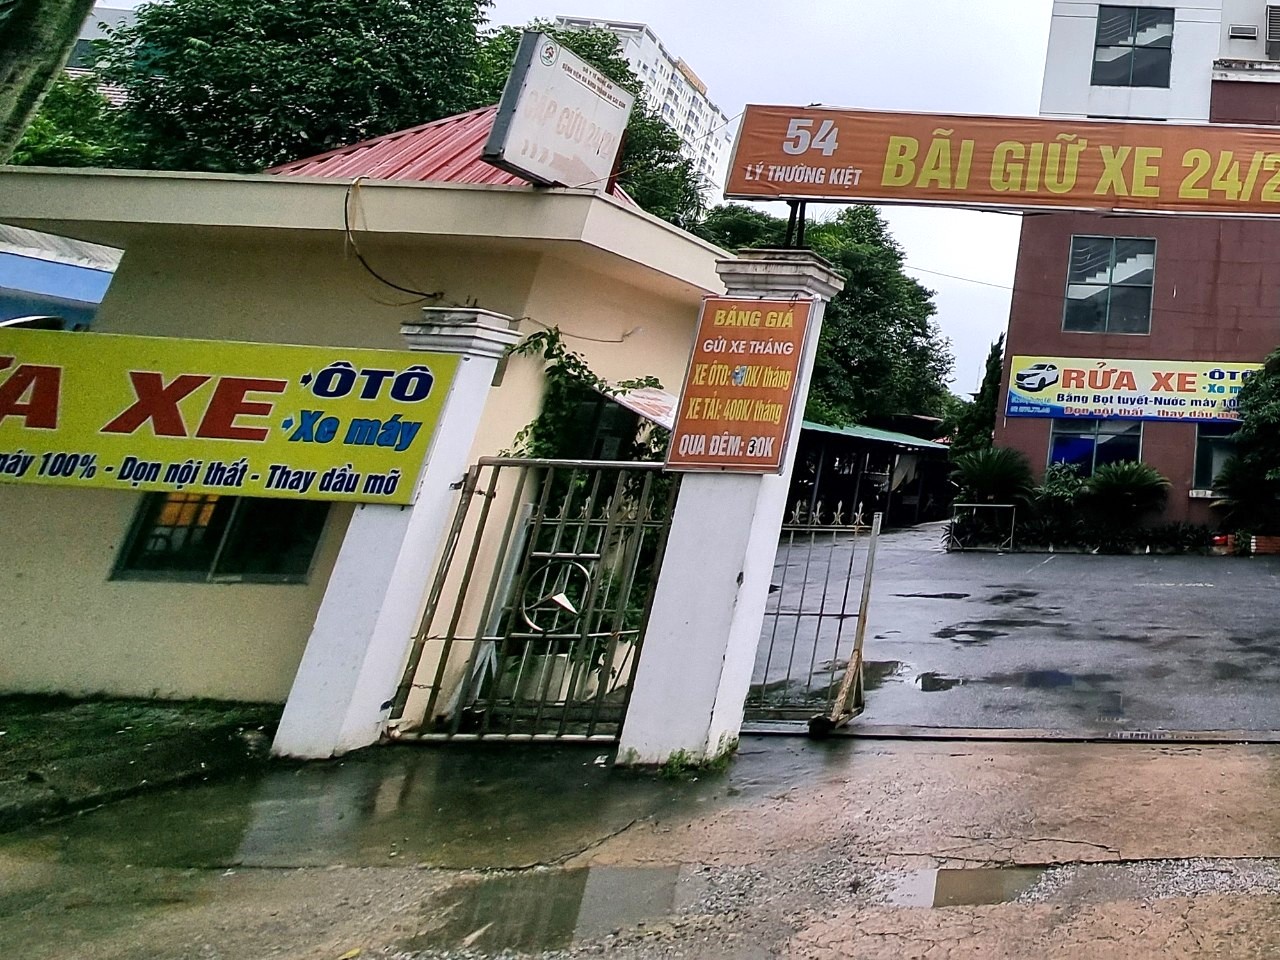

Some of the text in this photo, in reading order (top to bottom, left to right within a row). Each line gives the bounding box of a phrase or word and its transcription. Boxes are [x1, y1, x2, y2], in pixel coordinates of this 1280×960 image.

[782, 118, 840, 156] 54
[745, 161, 863, 189] LÝ THƯỜNG KIỆT
[881, 128, 975, 190] BÃI
[990, 133, 1088, 194] GIỮ
[1094, 145, 1163, 198] XE
[713, 305, 794, 328] BẢNG GIÁ
[702, 335, 795, 355] GỬI XE THÁNG
[313, 361, 435, 403] ÔTÔ
[692, 363, 709, 386] XE
[762, 365, 793, 391] tháng
[1061, 361, 1198, 393] RỬA XE
[1207, 383, 1225, 394] Xe
[100, 372, 288, 442] XE
[685, 397, 702, 420] XE
[722, 398, 754, 422] 400K/
[752, 398, 784, 426] tháng
[1092, 394, 1114, 406] Bọt
[1190, 397, 1217, 409] máy
[289, 410, 422, 452] Xe máy
[679, 434, 707, 457] QUA
[708, 430, 744, 457] ĐÊM:
[38, 452, 98, 479] 100%
[117, 456, 163, 487] Dọn
[163, 460, 203, 490] nội
[203, 458, 249, 487] thất
[265, 464, 318, 494] Thay
[318, 463, 362, 494] dầu
[362, 469, 401, 496] mỡ
